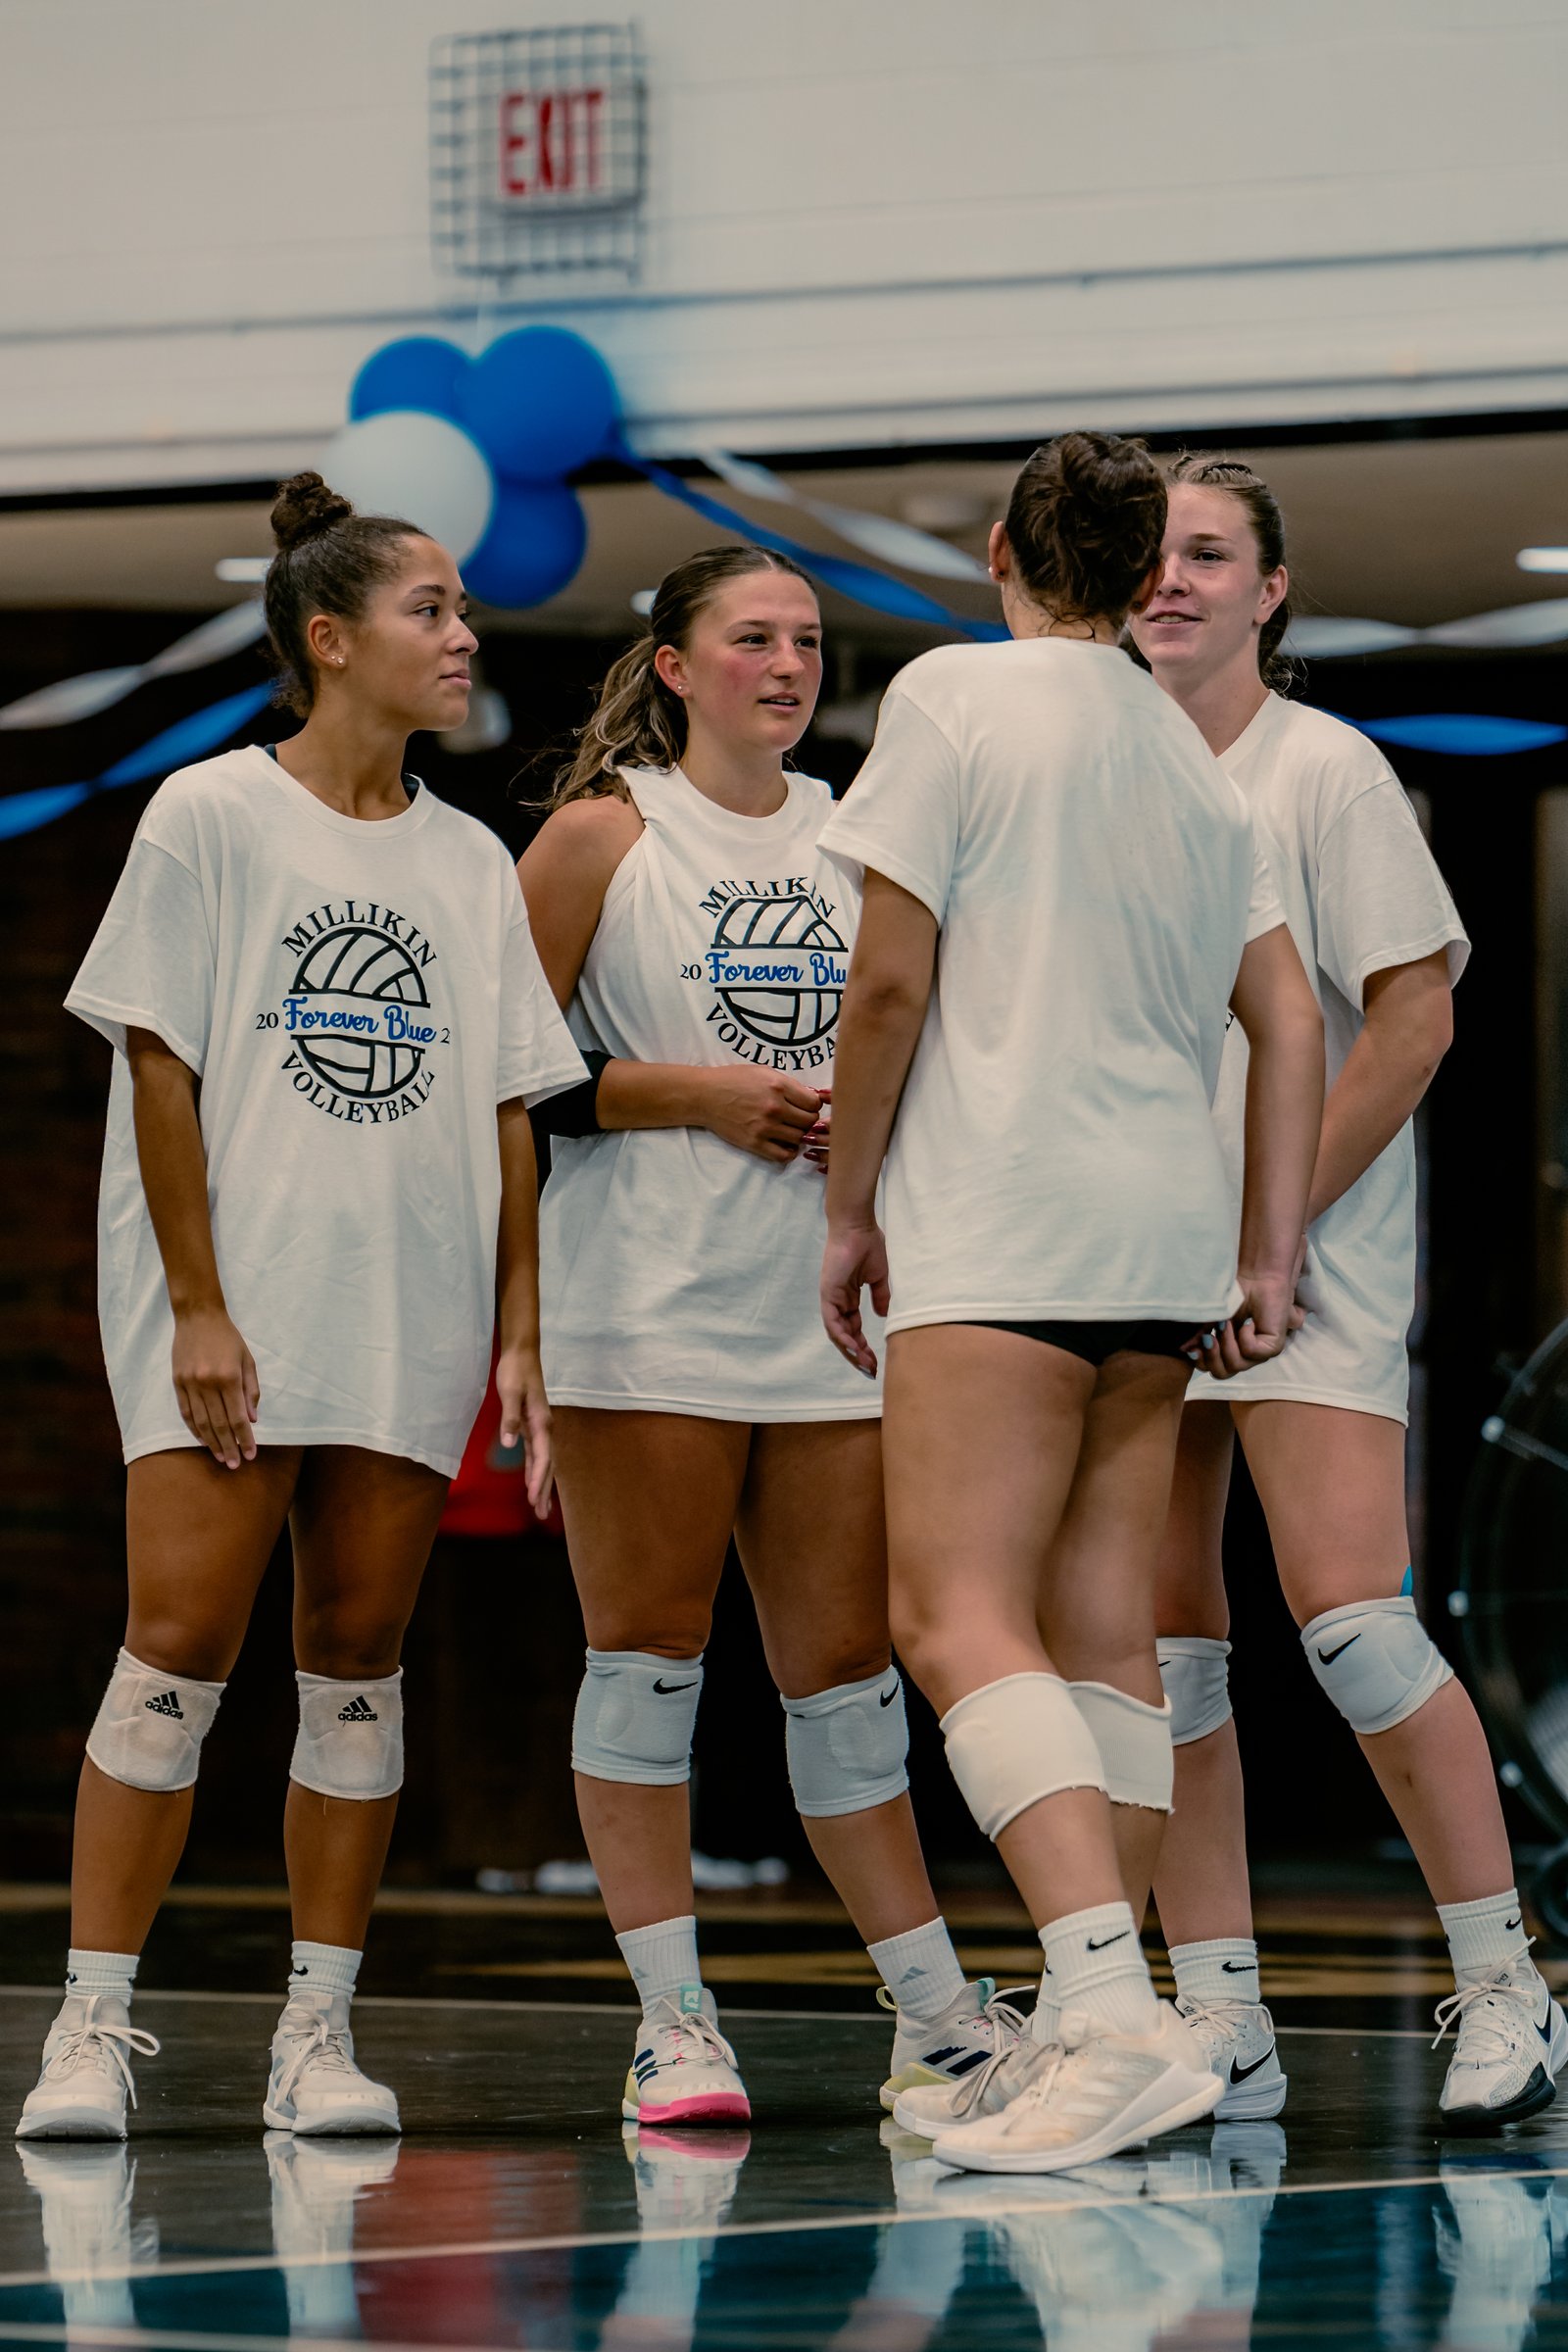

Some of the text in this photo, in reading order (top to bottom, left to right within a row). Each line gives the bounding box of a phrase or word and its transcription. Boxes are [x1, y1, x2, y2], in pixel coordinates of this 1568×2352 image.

[499, 88, 604, 196] EXIT
[698, 877, 837, 918] MILLIKIN
[281, 900, 437, 967] MILLIKIN
[680, 951, 846, 986] 20 Forever Blu
[256, 1012, 278, 1030] 20
[282, 996, 379, 1033] Forever
[383, 1004, 437, 1044] Blue
[706, 1002, 839, 1071] VOLLEYBA
[281, 1050, 435, 1124] VOLLEYBALL
[145, 1699, 184, 1720] adidas
[338, 1711, 377, 1722] adidas
